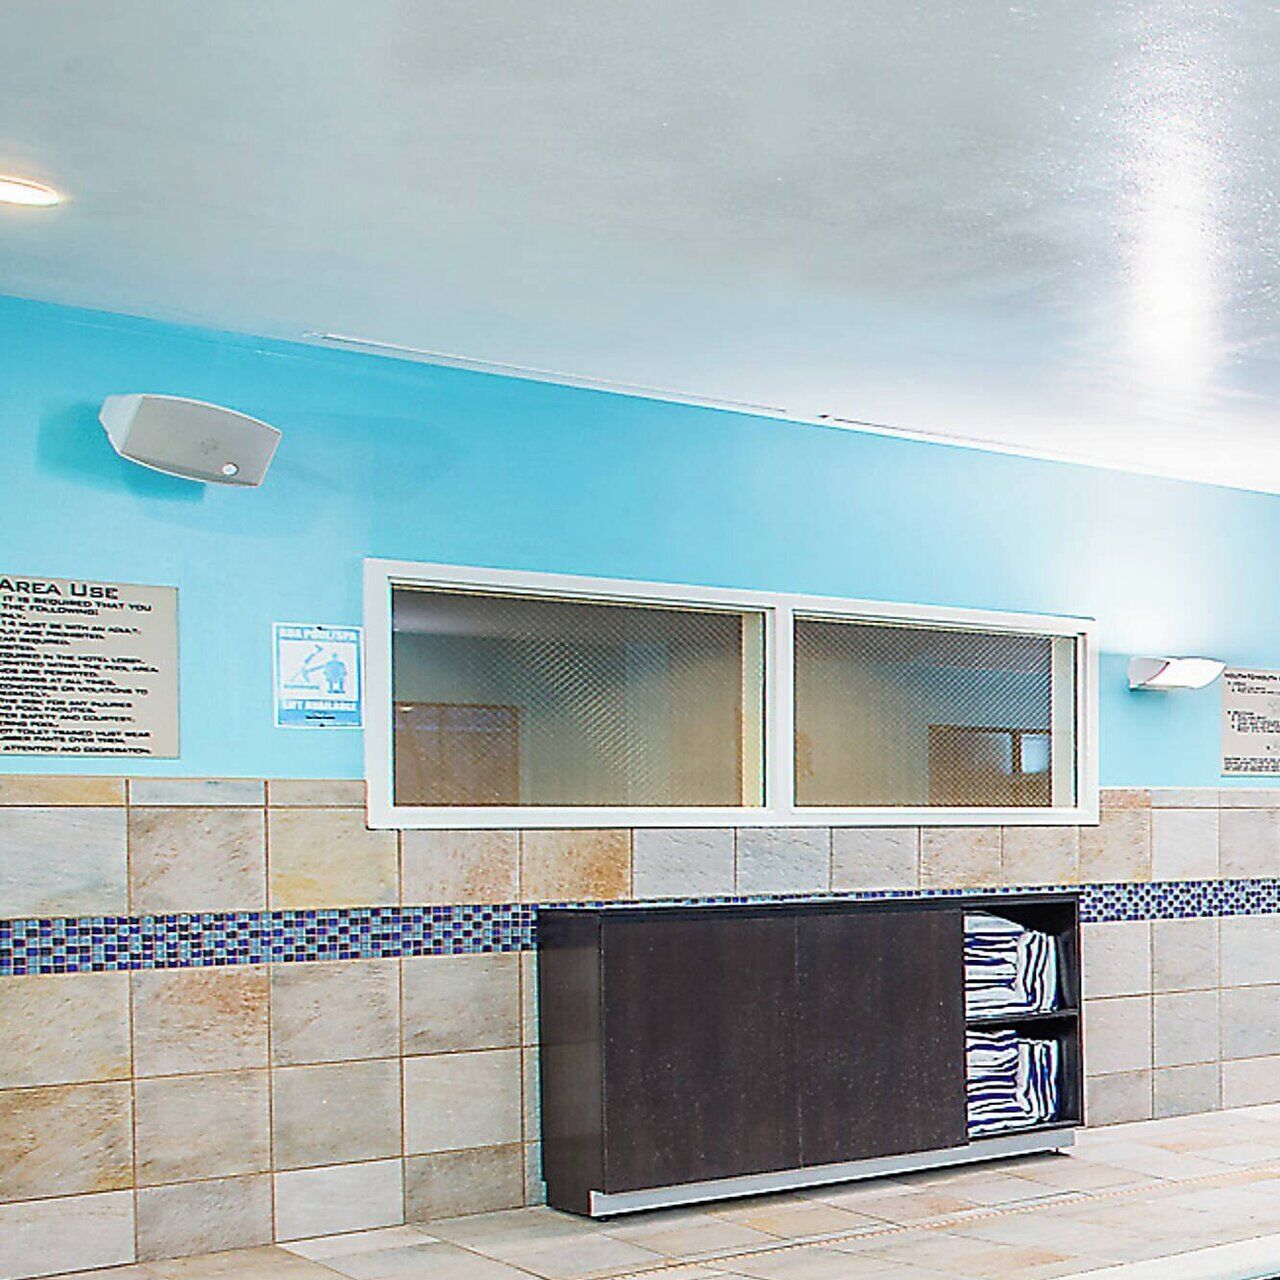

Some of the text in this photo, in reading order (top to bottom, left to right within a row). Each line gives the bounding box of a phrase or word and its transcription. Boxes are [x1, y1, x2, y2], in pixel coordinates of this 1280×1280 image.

[0, 579, 118, 599] AREA USE
[1, 603, 26, 611] THE
[34, 597, 92, 607] REQUIRED
[95, 601, 125, 609] THAT
